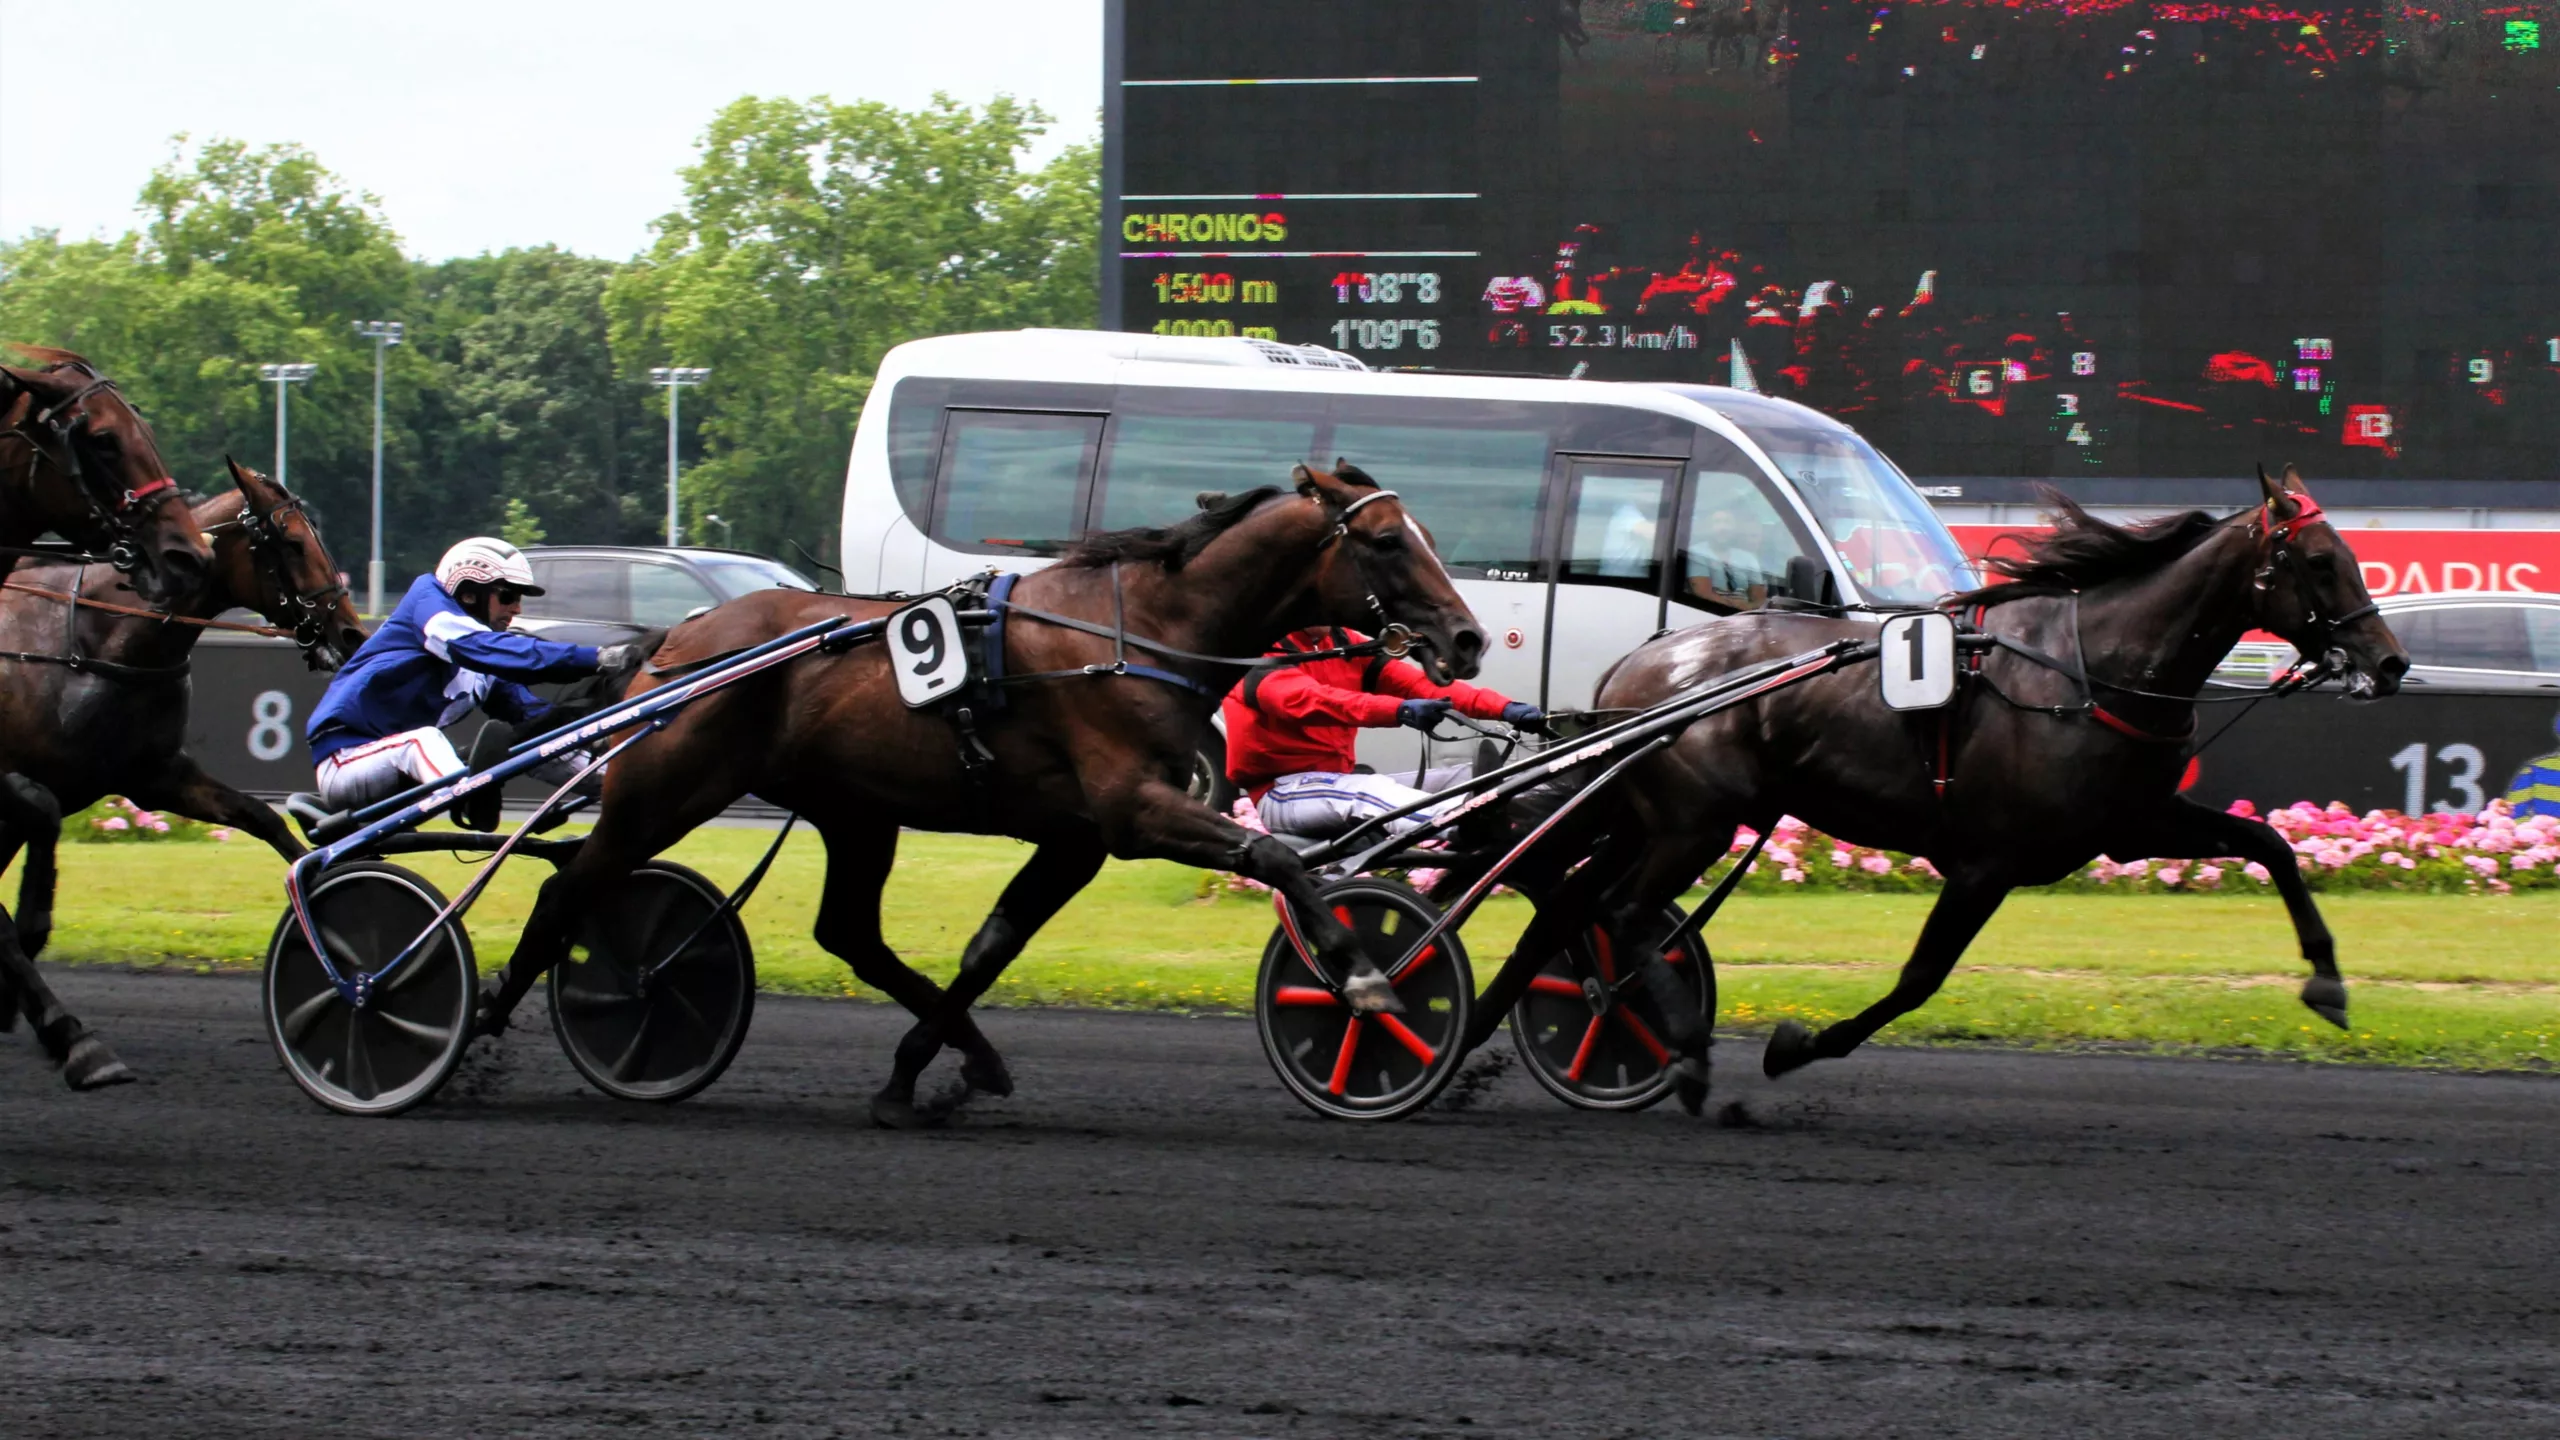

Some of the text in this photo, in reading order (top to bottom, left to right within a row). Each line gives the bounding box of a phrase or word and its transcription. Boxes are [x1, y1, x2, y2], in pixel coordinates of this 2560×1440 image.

[1123, 212, 1287, 242] CHRONOS
[1153, 273, 1278, 303] 1500 m
[1549, 324, 1699, 350] 52.3 km/h
[2072, 352, 2095, 375] 8
[2468, 358, 2494, 383] 9
[1968, 369, 1994, 394] 6
[2056, 393, 2079, 416] 3
[2066, 422, 2092, 446] 4
[2355, 413, 2393, 437] 13
[901, 607, 946, 677] 9
[1902, 618, 1924, 681] 1
[247, 690, 292, 760] 8
[2389, 742, 2486, 821] 13
